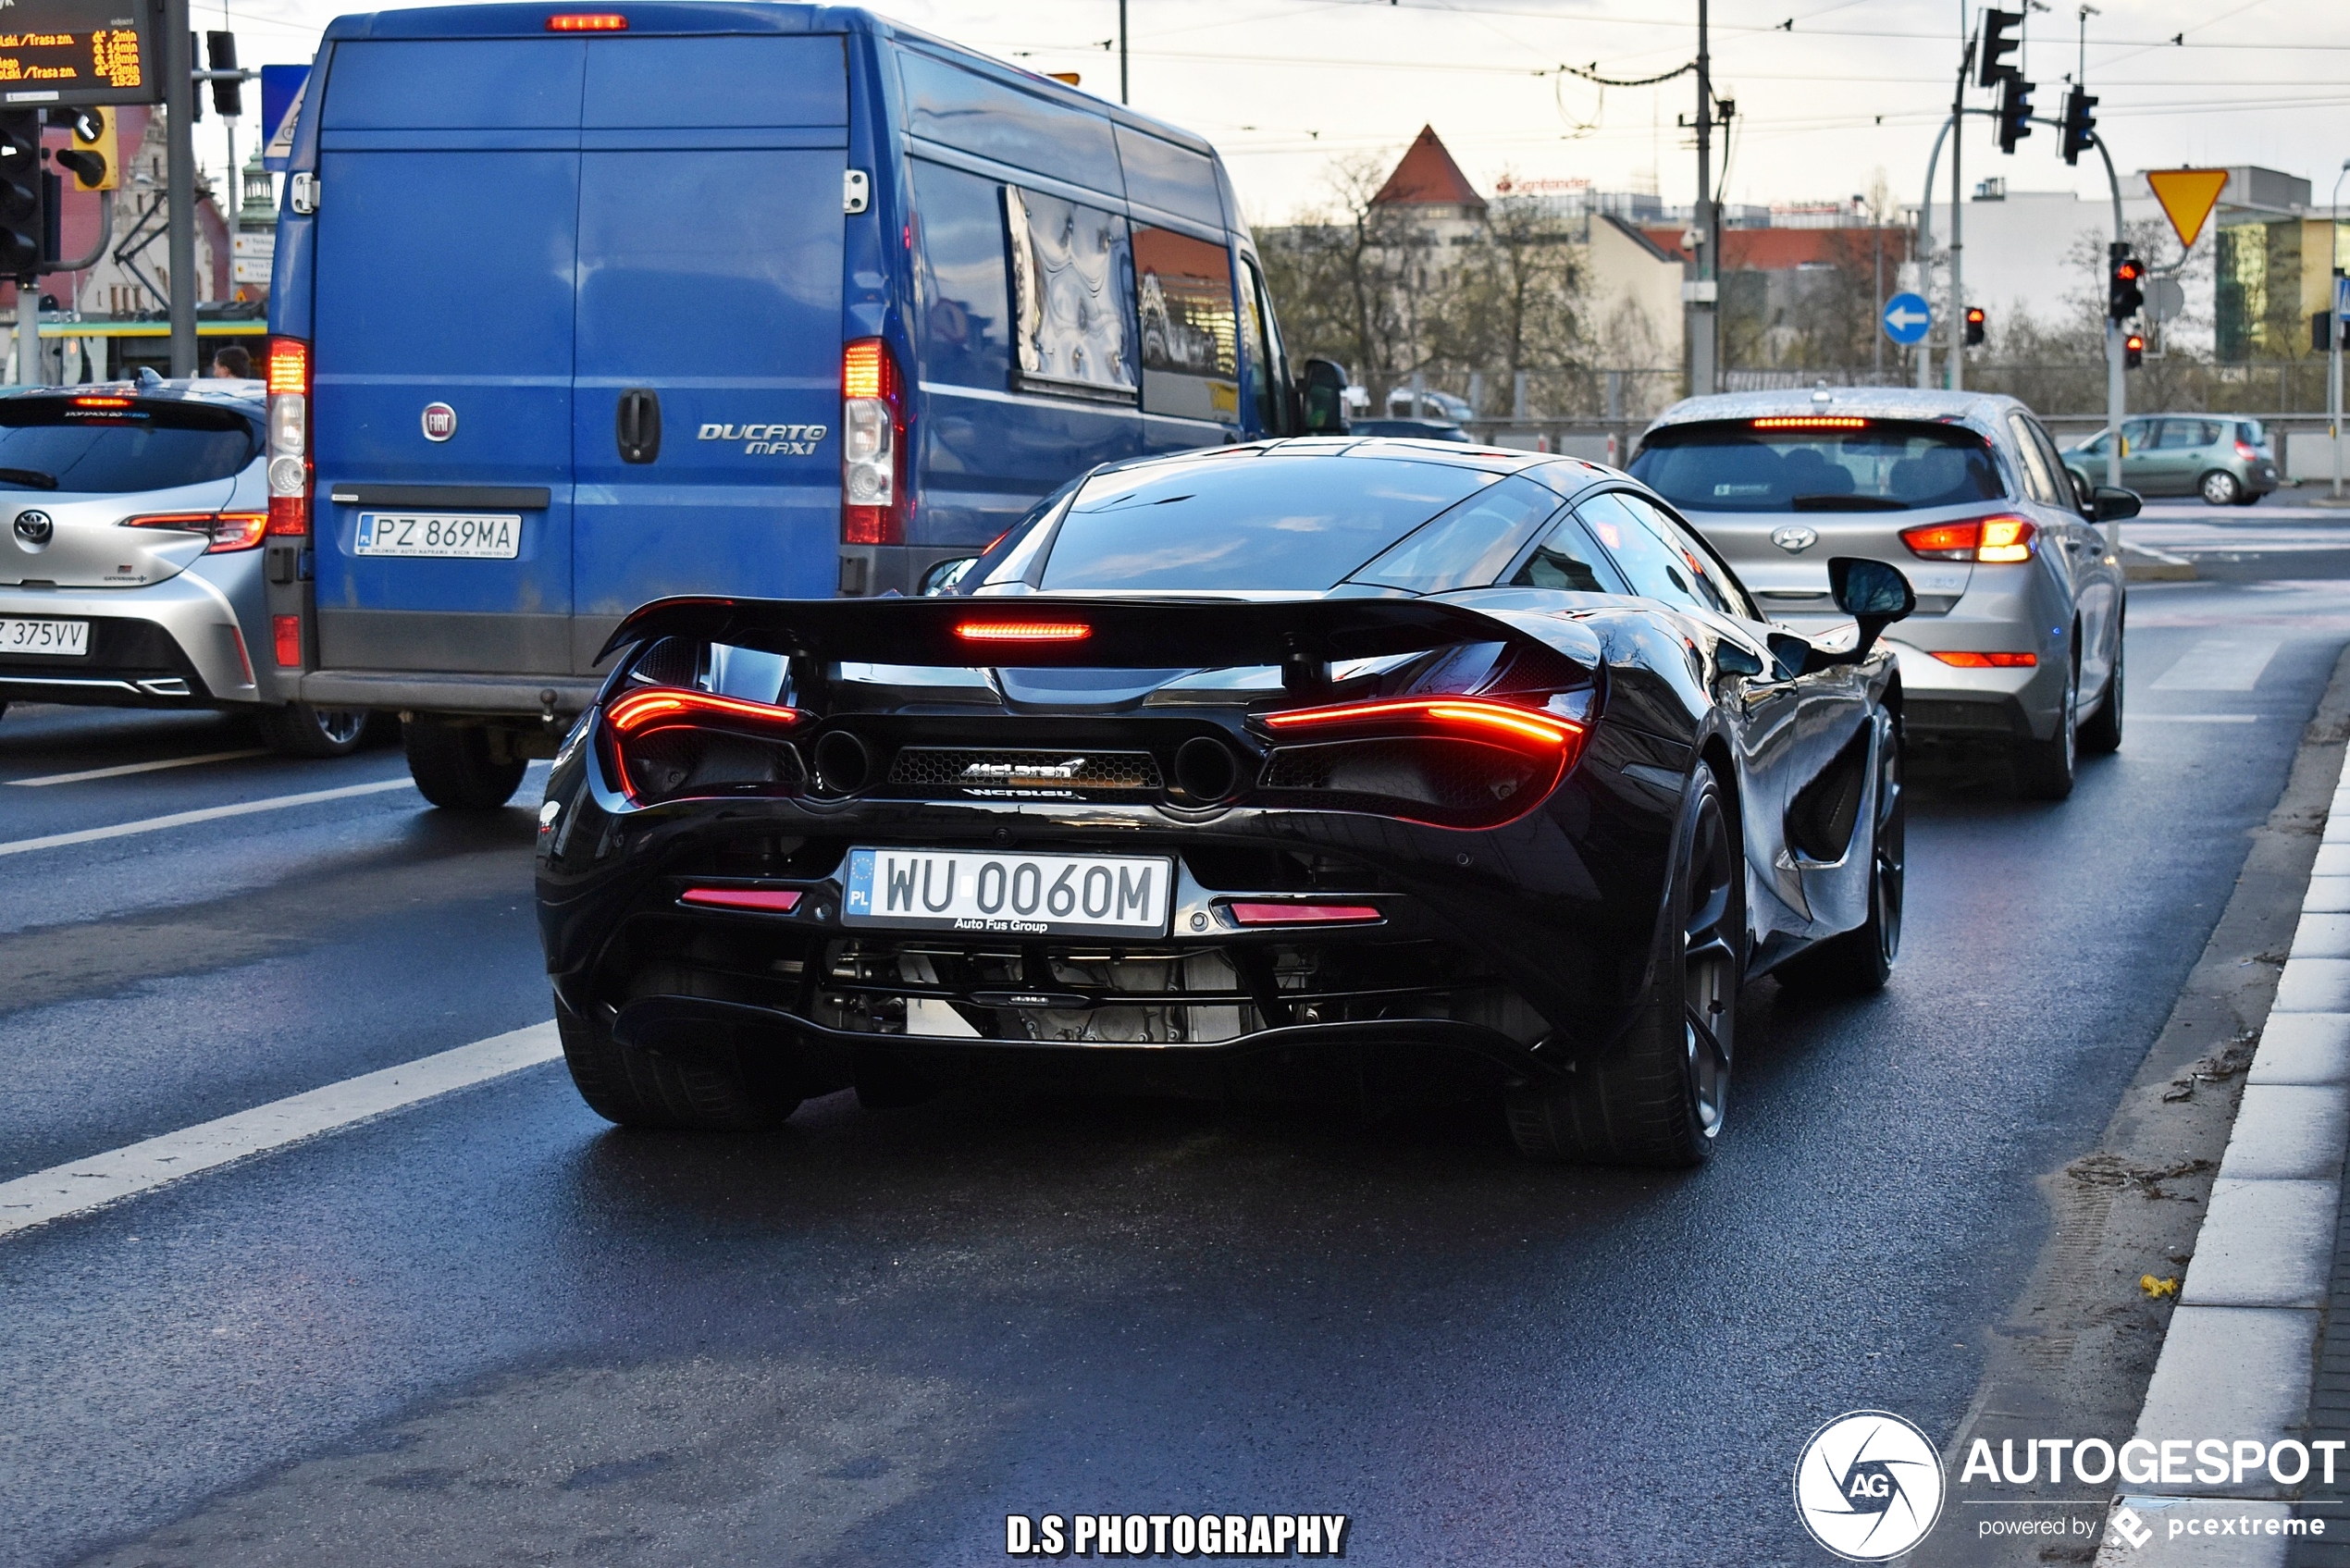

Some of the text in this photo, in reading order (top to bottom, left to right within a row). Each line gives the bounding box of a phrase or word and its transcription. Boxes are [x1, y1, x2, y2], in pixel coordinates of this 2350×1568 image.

[56, 34, 74, 44] zm.
[60, 68, 77, 78] zm.
[428, 414, 450, 431] FIAT
[698, 424, 828, 440] DUCATO
[745, 441, 817, 455] MAXI
[360, 536, 370, 544] PL
[376, 519, 510, 548] PZ 869MA
[13, 623, 82, 647] 375VV
[961, 758, 1085, 778] McLaren
[886, 858, 1152, 921] WU 0060M
[850, 891, 869, 907] PL
[954, 918, 1048, 934] Auto Fus Group
